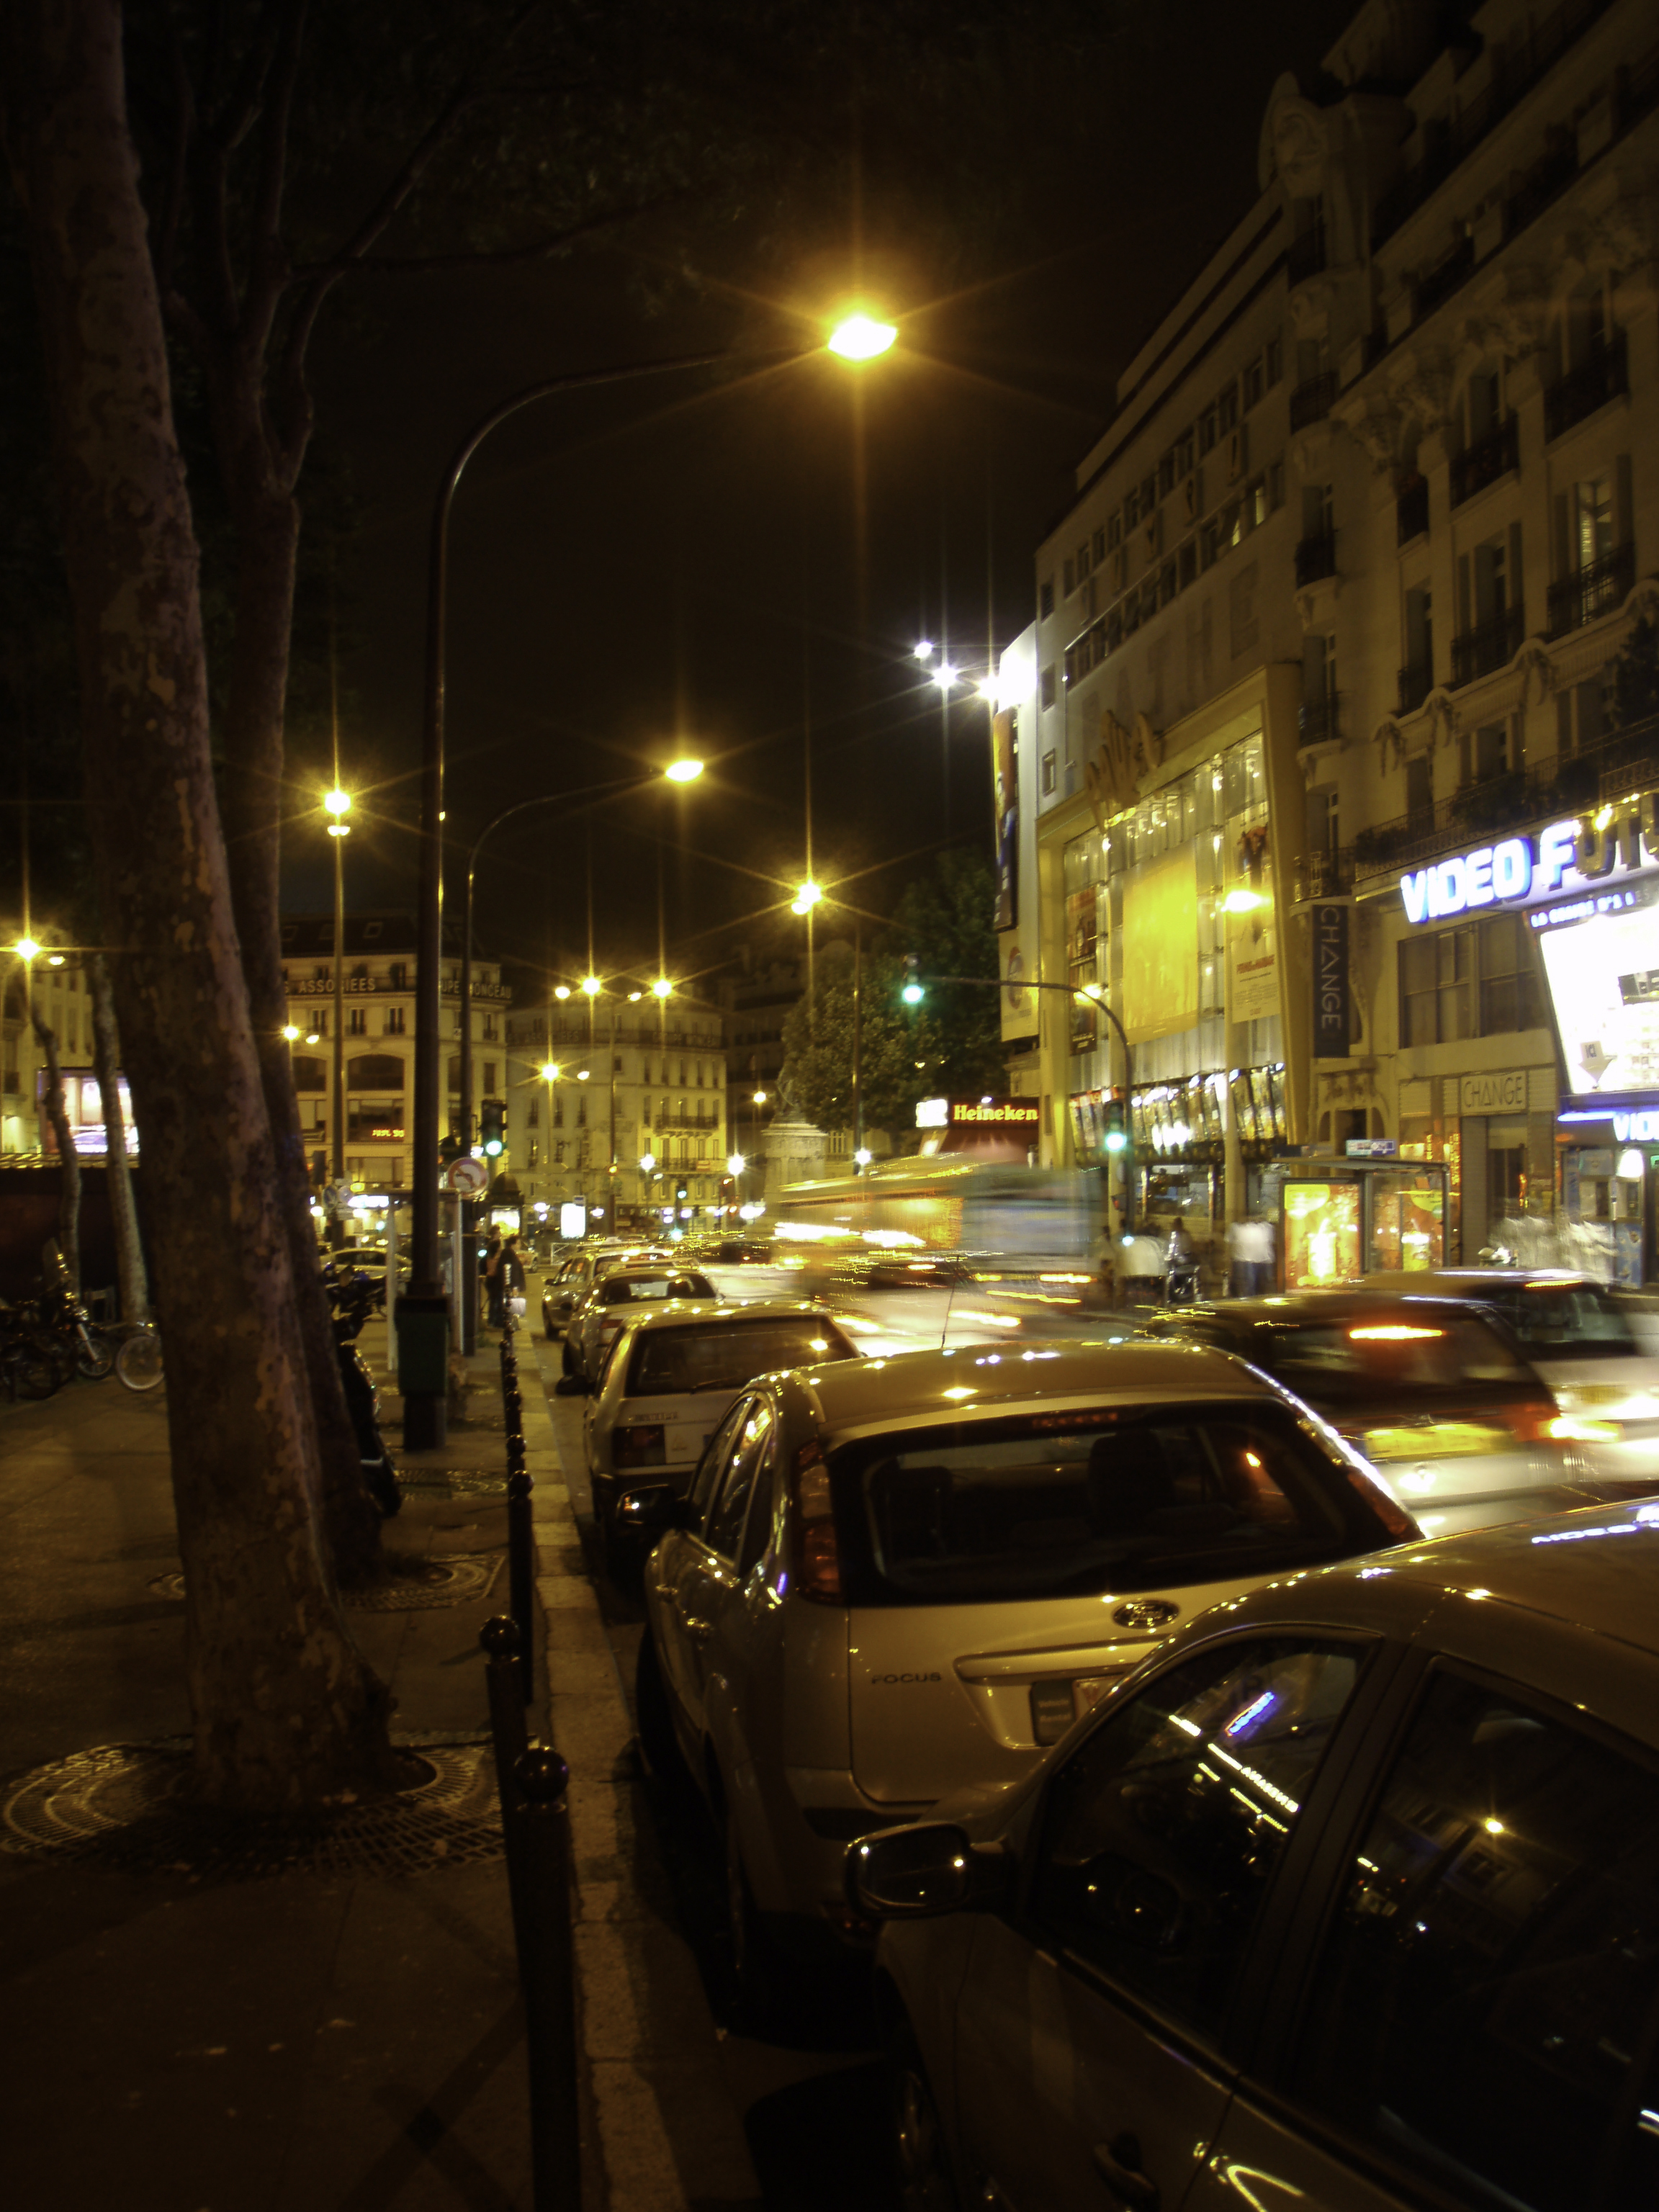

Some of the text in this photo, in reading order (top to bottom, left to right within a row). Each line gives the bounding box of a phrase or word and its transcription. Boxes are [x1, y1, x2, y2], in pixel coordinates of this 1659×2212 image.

[1401, 837, 1532, 924] VIDEO
[1321, 907, 1341, 1029] CHANGE
[299, 978, 376, 994] ASSOIEES
[1464, 1076, 1522, 1107] CHANGE
[953, 1105, 1039, 1121] Heineken
[871, 1672, 942, 1684] FOCUS
